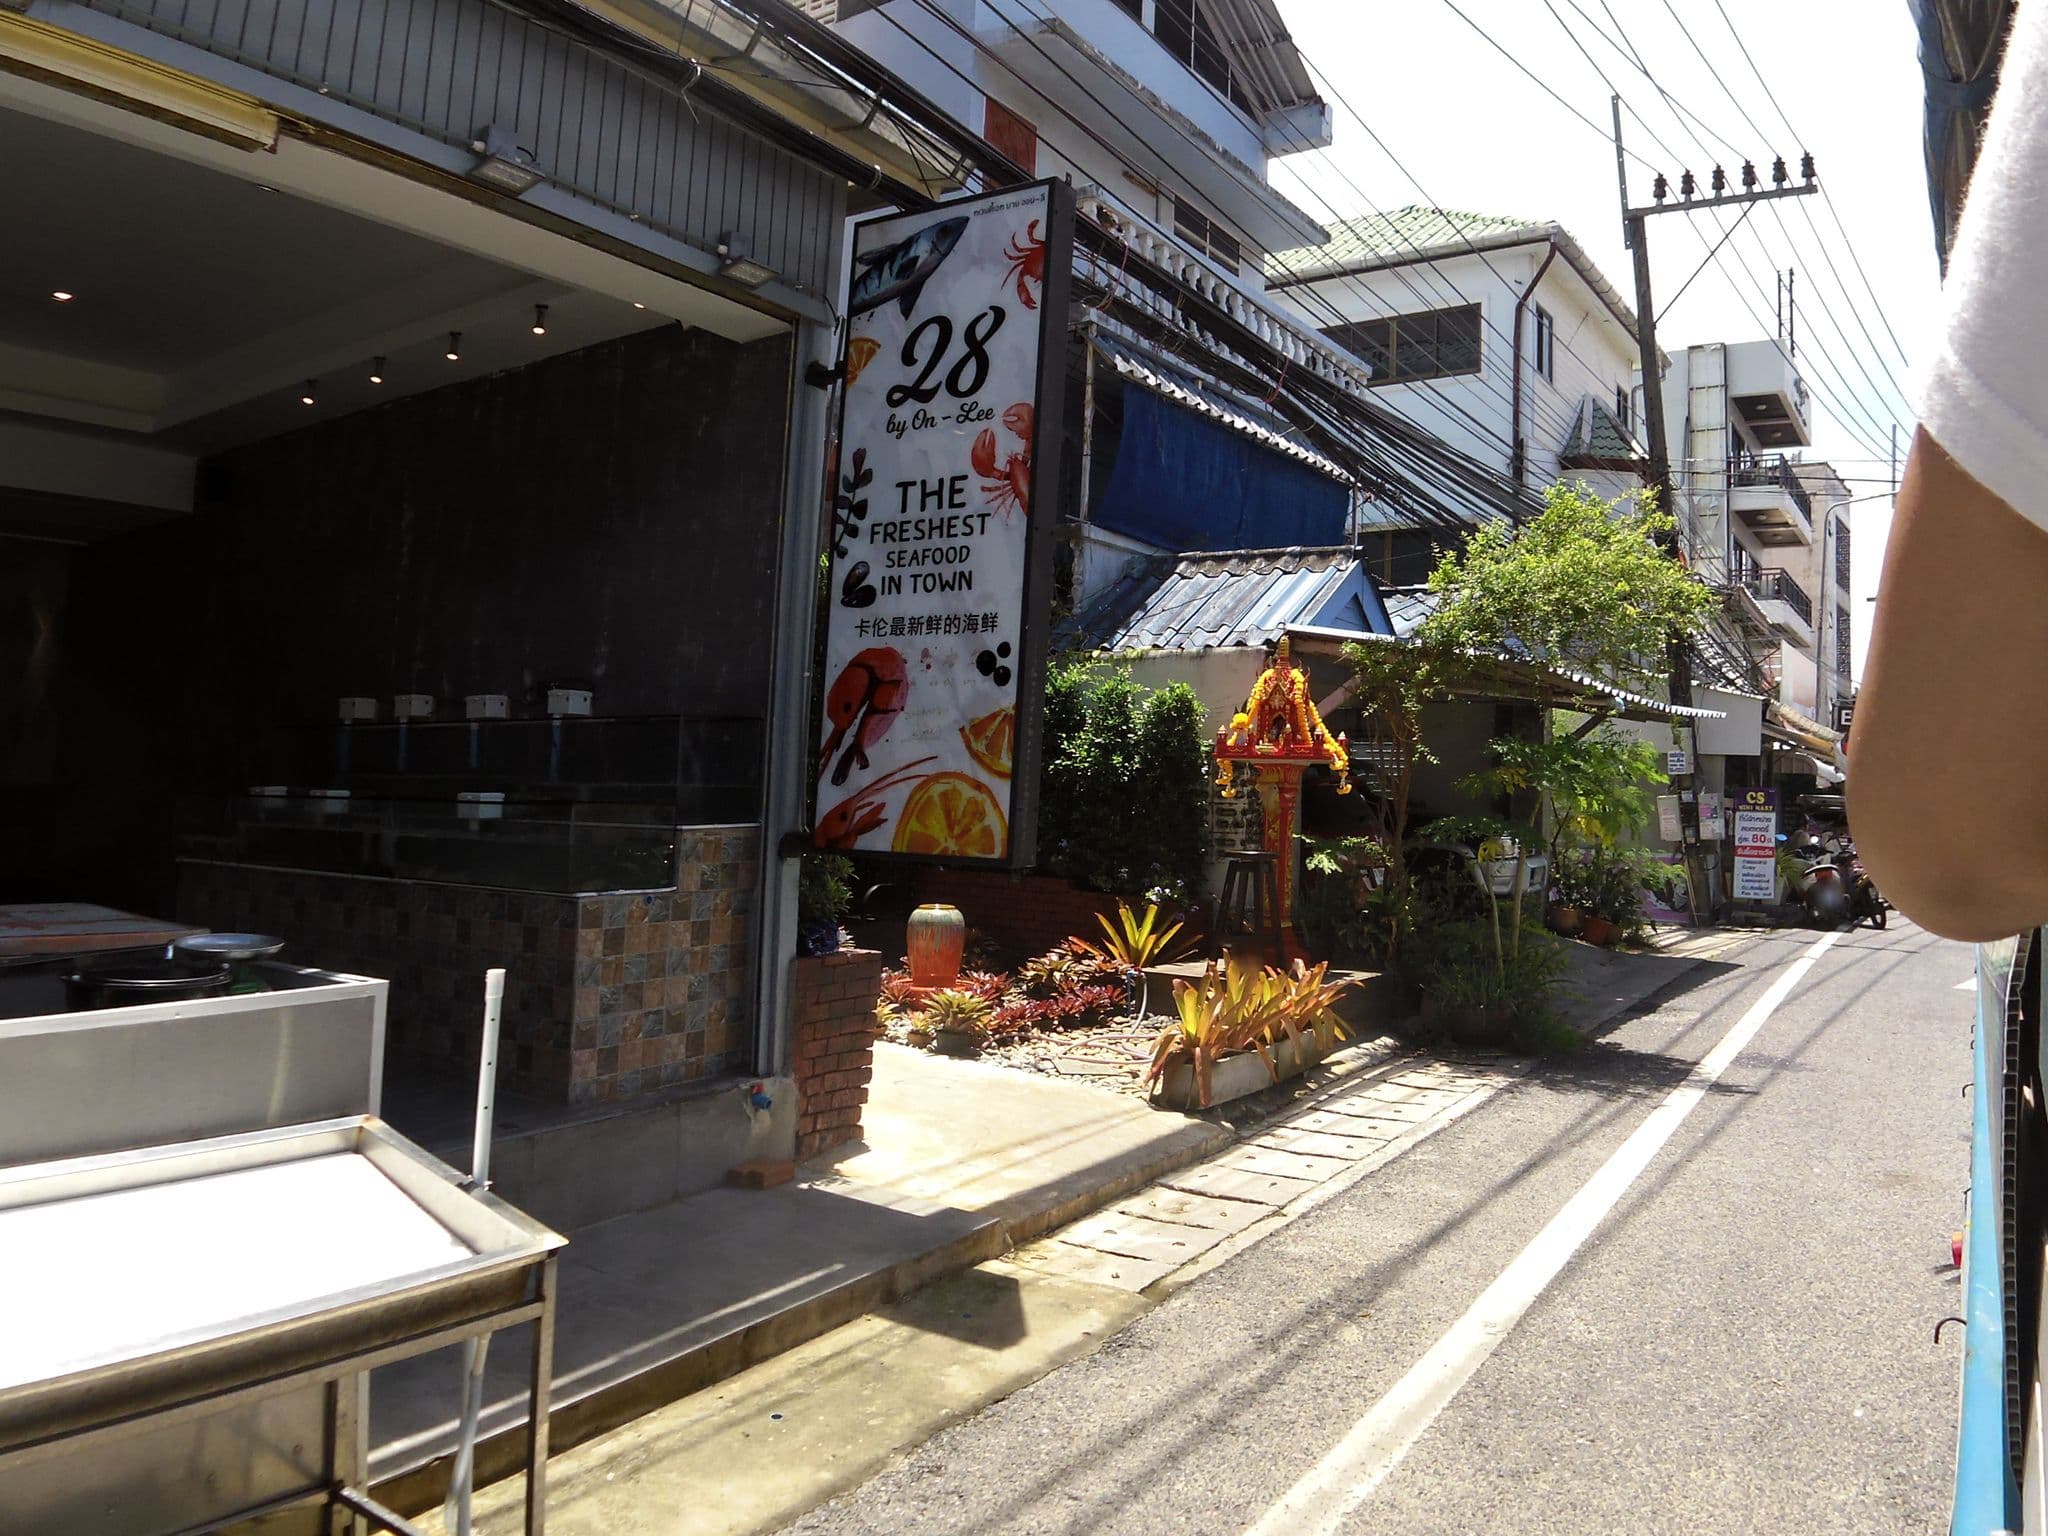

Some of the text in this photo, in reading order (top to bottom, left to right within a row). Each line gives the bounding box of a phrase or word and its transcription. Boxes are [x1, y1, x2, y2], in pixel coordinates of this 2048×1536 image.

[886, 305, 1006, 408] 28
[886, 413, 908, 440] by
[911, 408, 938, 431] On
[956, 400, 996, 424] Lee
[895, 474, 969, 514] THE
[869, 512, 992, 545] FRESHEST
[885, 545, 971, 569] SEAFOOD
[881, 570, 973, 596] IN TOWN
[854, 612, 999, 638] 卡伦最新鲜的海鲜
[1746, 791, 1765, 804] CS
[1751, 833, 1766, 843] 80
